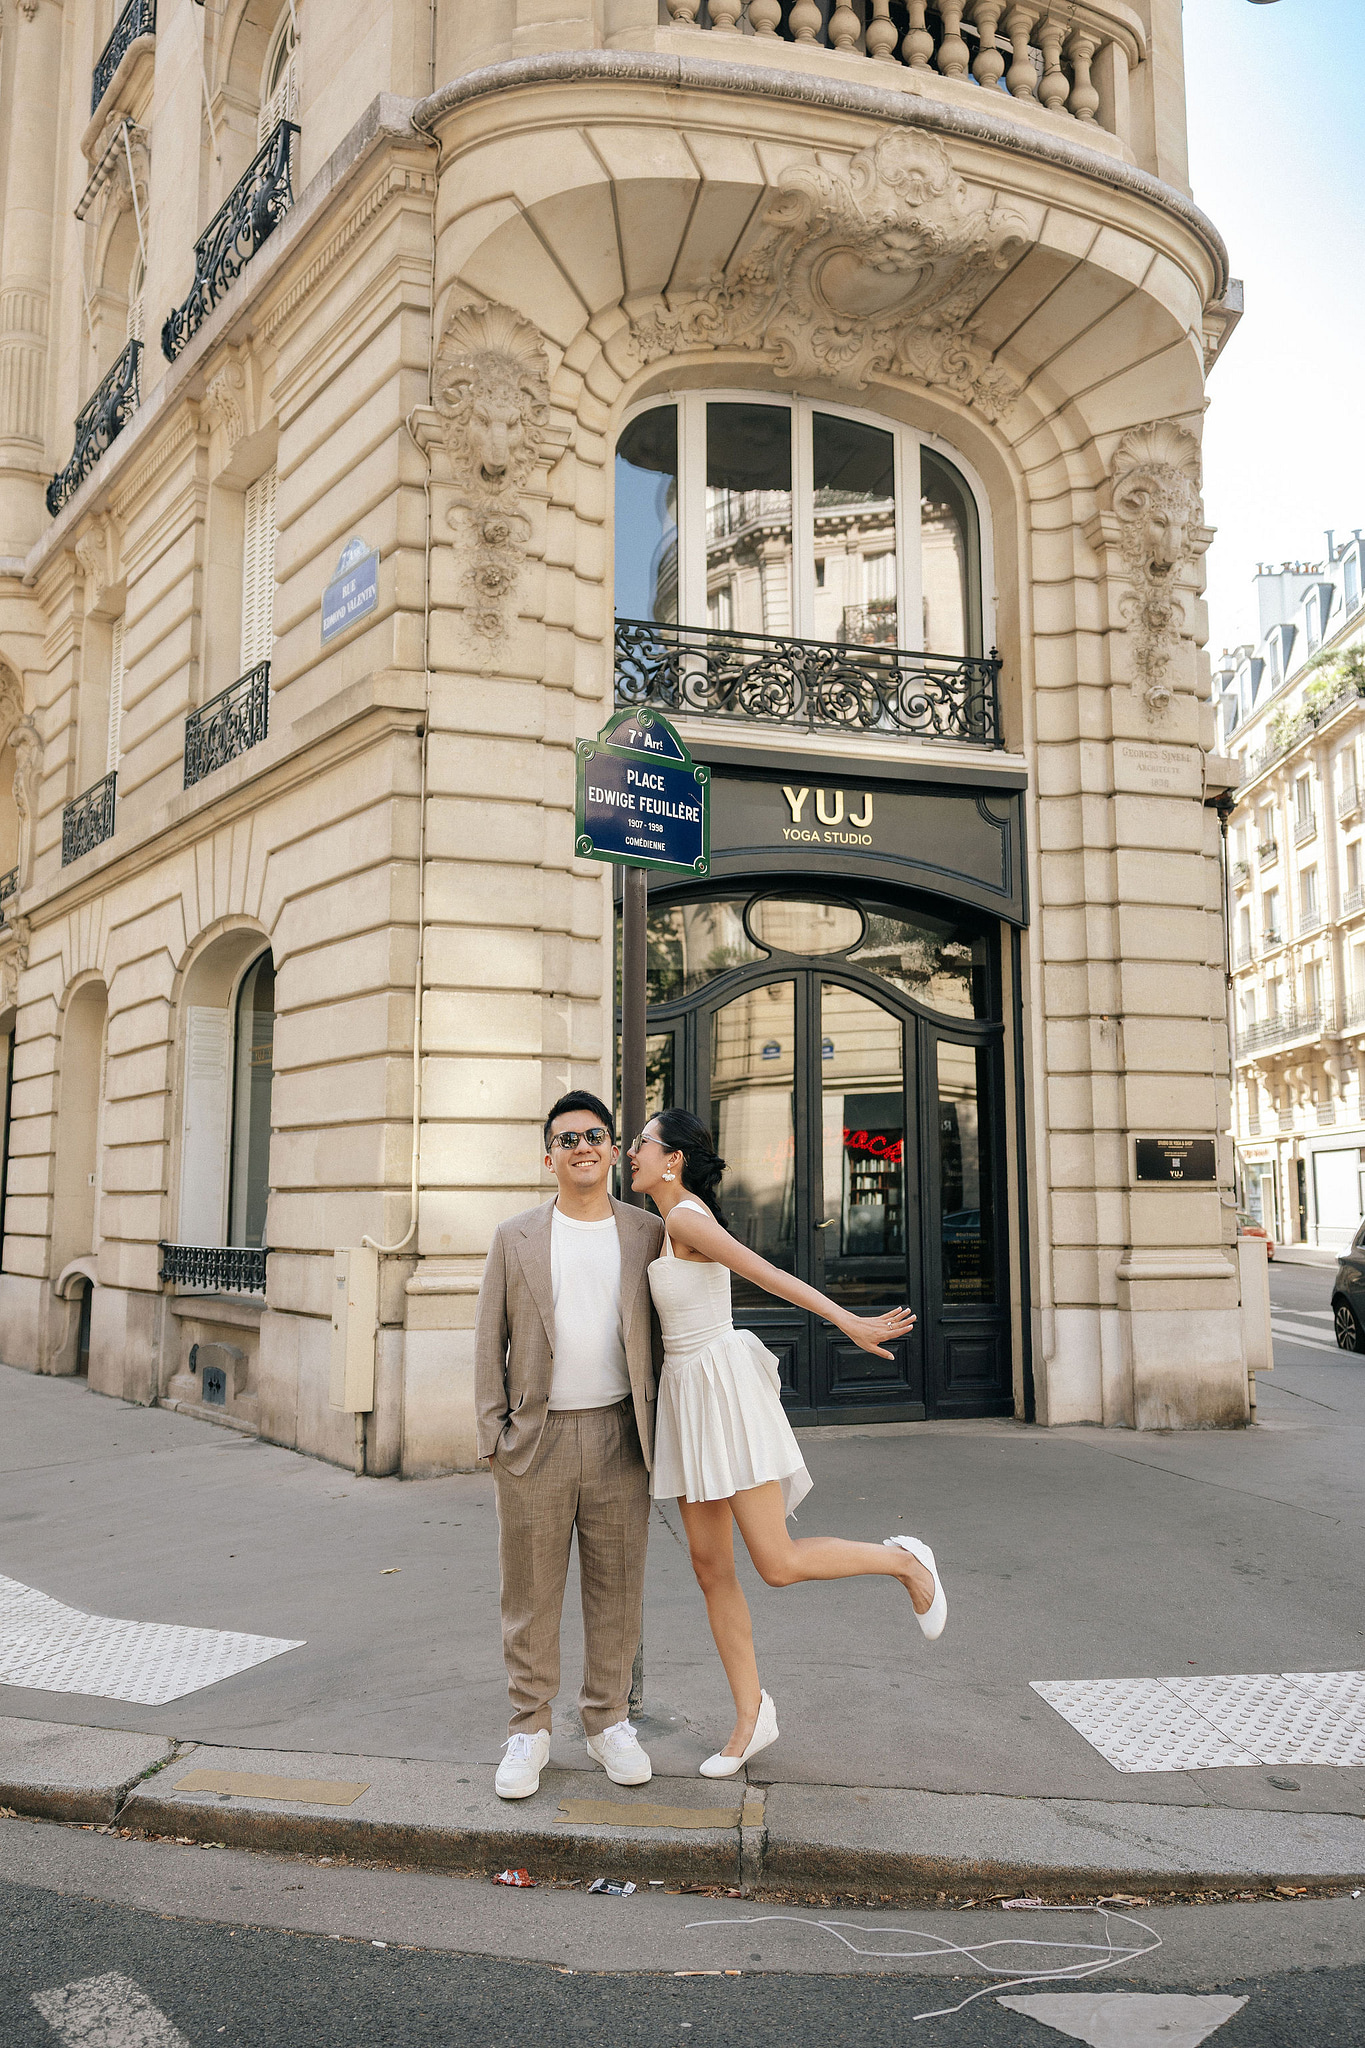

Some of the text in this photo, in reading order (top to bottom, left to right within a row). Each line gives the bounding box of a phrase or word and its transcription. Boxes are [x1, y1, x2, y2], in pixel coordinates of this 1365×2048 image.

[342, 579, 356, 599] RUE
[627, 769, 665, 792] PLACE
[588, 786, 700, 823] EDWIGE FEUILLÈRE
[782, 786, 873, 828] YUJ
[625, 836, 666, 852] COMÉDIENNE
[782, 828, 872, 846] YOGA STUDIO
[1170, 1170, 1184, 1178] YUJ
